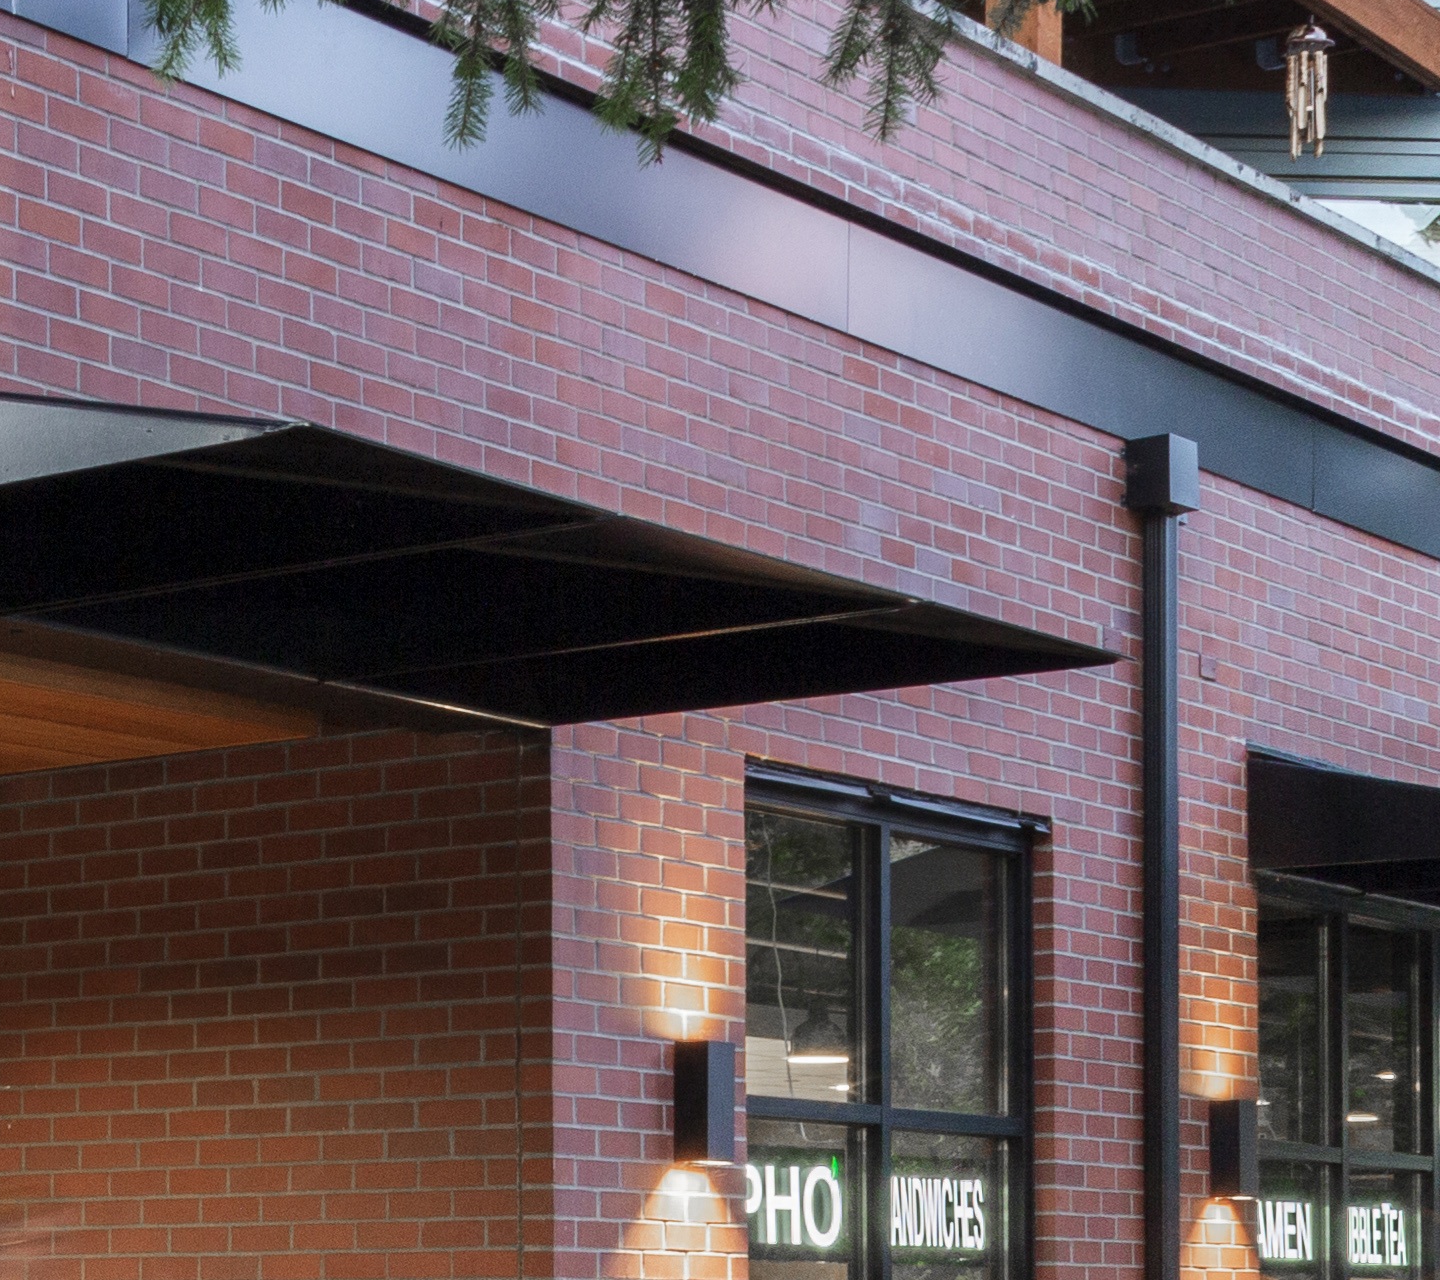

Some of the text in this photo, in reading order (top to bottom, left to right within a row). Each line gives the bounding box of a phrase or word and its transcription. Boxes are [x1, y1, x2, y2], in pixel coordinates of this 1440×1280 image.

[890, 1176, 985, 1250] ANDWICHES
[1256, 1199, 1313, 1261] AMEN
[1348, 1203, 1408, 1266] BBLE TEA
